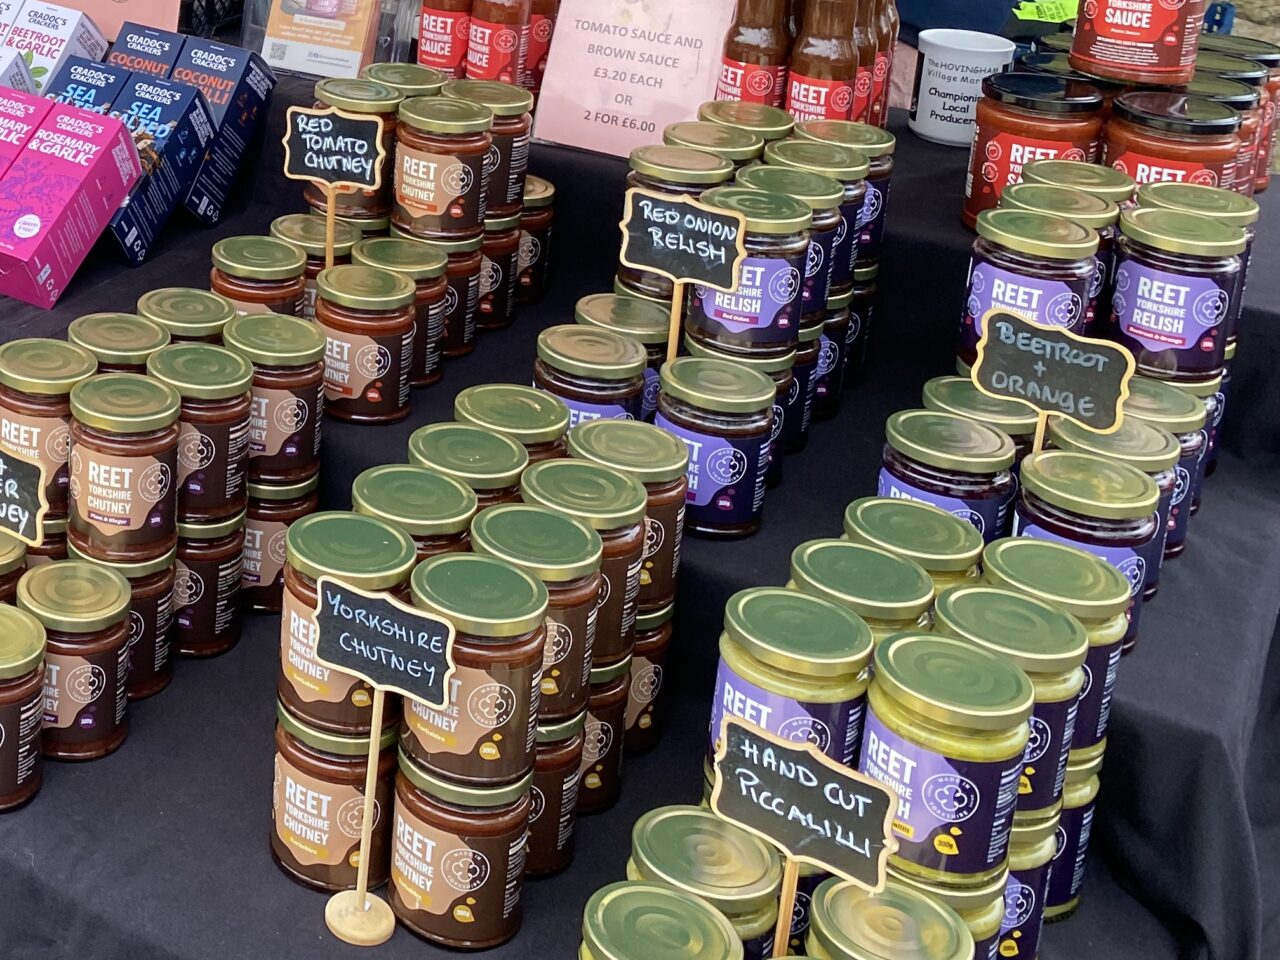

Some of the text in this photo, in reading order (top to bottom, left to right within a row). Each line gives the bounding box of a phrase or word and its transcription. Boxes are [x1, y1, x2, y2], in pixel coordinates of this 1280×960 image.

[1104, 8, 1152, 28] SAUCE
[10, 26, 66, 49] BEETROOT
[574, 19, 703, 50] TOMATO SAUCE AND
[15, 39, 61, 60] GARLIC
[587, 43, 680, 69] BROWN SAUCE
[174, 67, 235, 91] COCONUT
[593, 67, 664, 89] £3.20 EACH
[927, 69, 958, 83] Village
[940, 62, 999, 74] HOVINGHAM
[614, 93, 633, 106] OR
[928, 87, 981, 103] Championin
[942, 101, 970, 113] Local
[128, 101, 162, 122] SEA
[583, 110, 656, 133] 2 FOR £6.00
[929, 110, 977, 125] Producer
[296, 115, 333, 133] RED
[35, 128, 101, 155] ROSEMARY
[301, 134, 368, 155] TOMATO
[39, 142, 95, 167] GARLIC
[304, 151, 373, 181] CHUTNEY
[639, 200, 738, 241] RED ONION
[648, 227, 726, 265] RELISH
[1138, 276, 1191, 307] REET
[1136, 297, 1186, 318] YORKSHIRE
[1132, 308, 1184, 335] RELISH
[995, 321, 1110, 373] BEETROOT
[1033, 361, 1047, 378] +
[991, 370, 1096, 417] ORANGE
[88, 462, 133, 489] REET
[87, 495, 132, 515] CHUTNEY
[88, 485, 132, 501] YORKSHIRE
[325, 589, 443, 654] YORKSHIRE
[339, 632, 436, 687] CHUTNEY
[740, 739, 872, 818] HAND CUT
[285, 776, 333, 818] REET
[285, 800, 330, 830] YORKSHIRE
[735, 767, 871, 859] PICCALILLI
[283, 814, 329, 846] CHUTNEY
